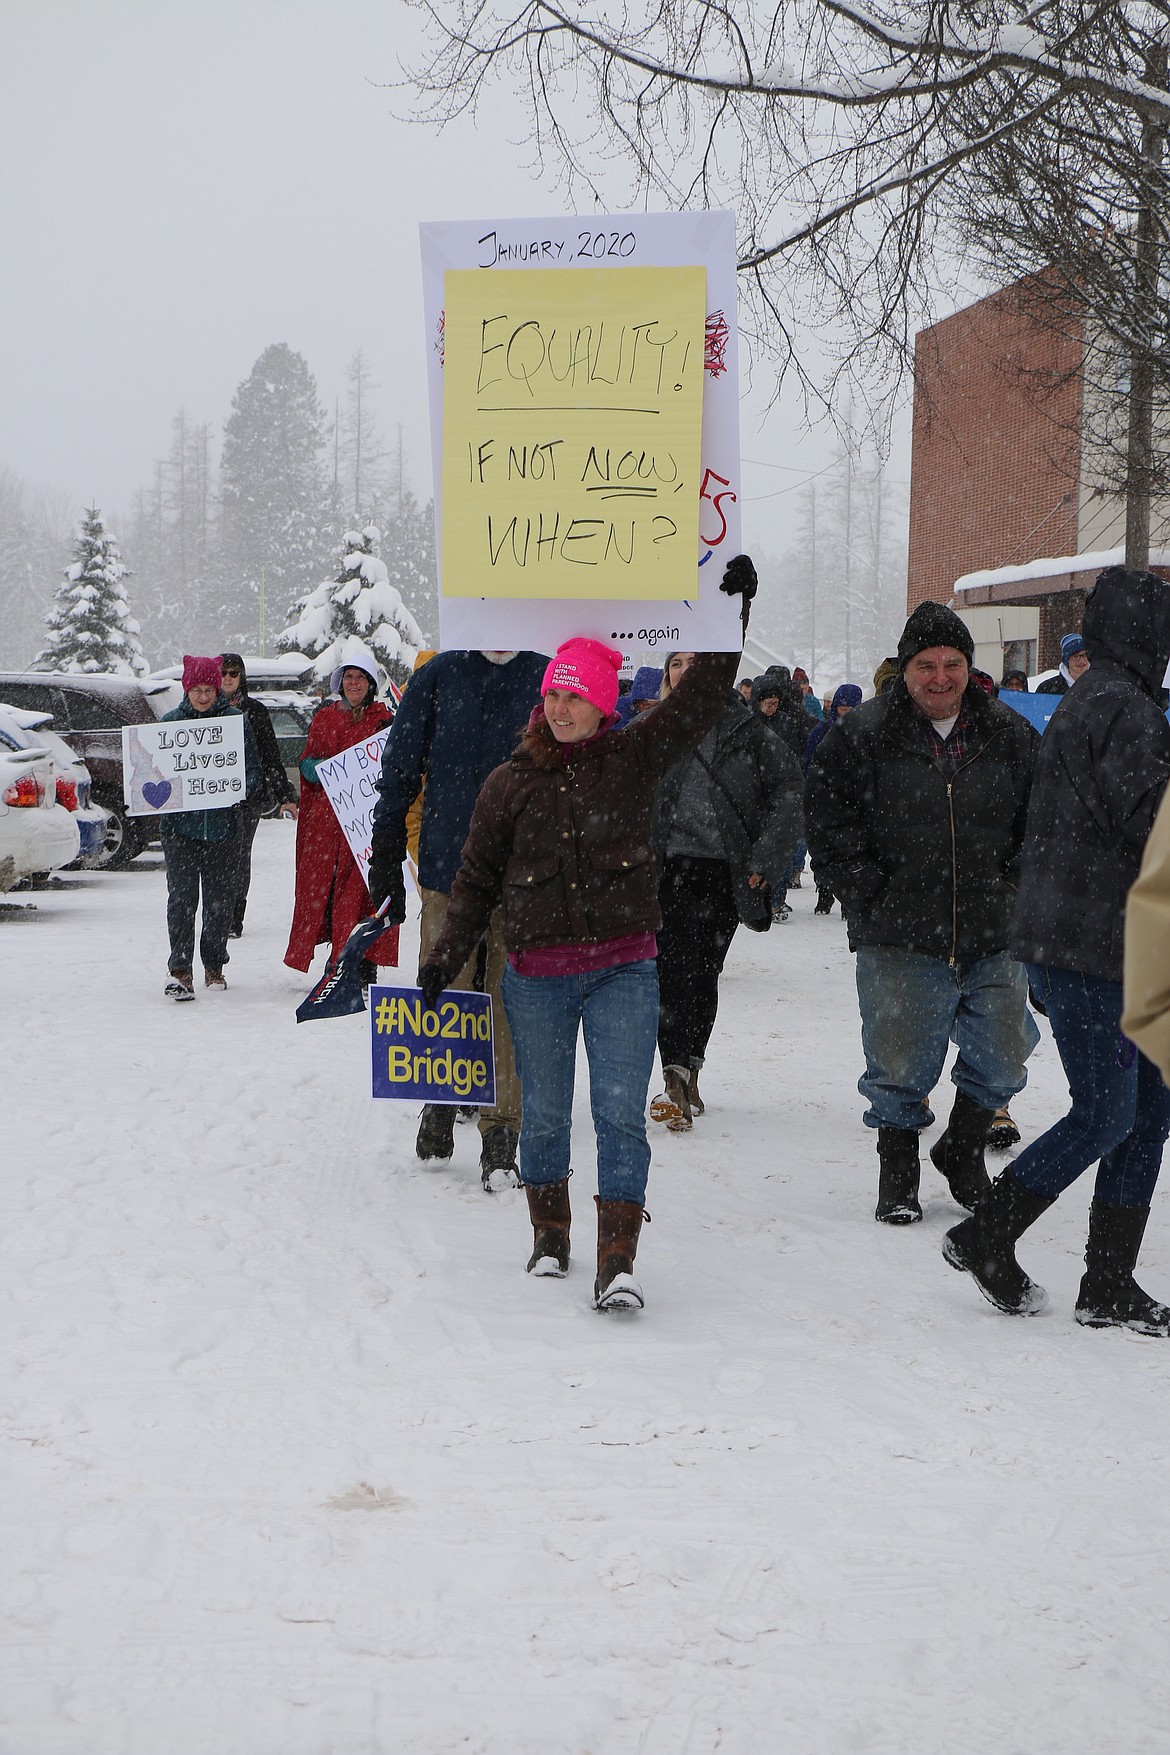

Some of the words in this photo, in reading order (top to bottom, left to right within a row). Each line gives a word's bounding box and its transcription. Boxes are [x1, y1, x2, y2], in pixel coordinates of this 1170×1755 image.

[577, 231, 637, 258] 2020
[477, 315, 690, 397] EQUALITY!
[468, 440, 494, 483] IF
[508, 440, 564, 481] NOT
[580, 446, 684, 493] NOW,
[487, 511, 677, 567] WHEN?
[553, 674, 580, 682] PLANNED
[558, 663, 577, 671] STAND
[552, 679, 589, 692] PARENTHOOD
[158, 725, 223, 749] LOVE
[173, 750, 237, 771] Lives
[320, 754, 349, 787] MY
[188, 777, 241, 796] Here
[332, 784, 356, 814] MY
[344, 813, 368, 843] MY
[375, 996, 491, 1041] #No2nd
[388, 1045, 487, 1095] Bridge
